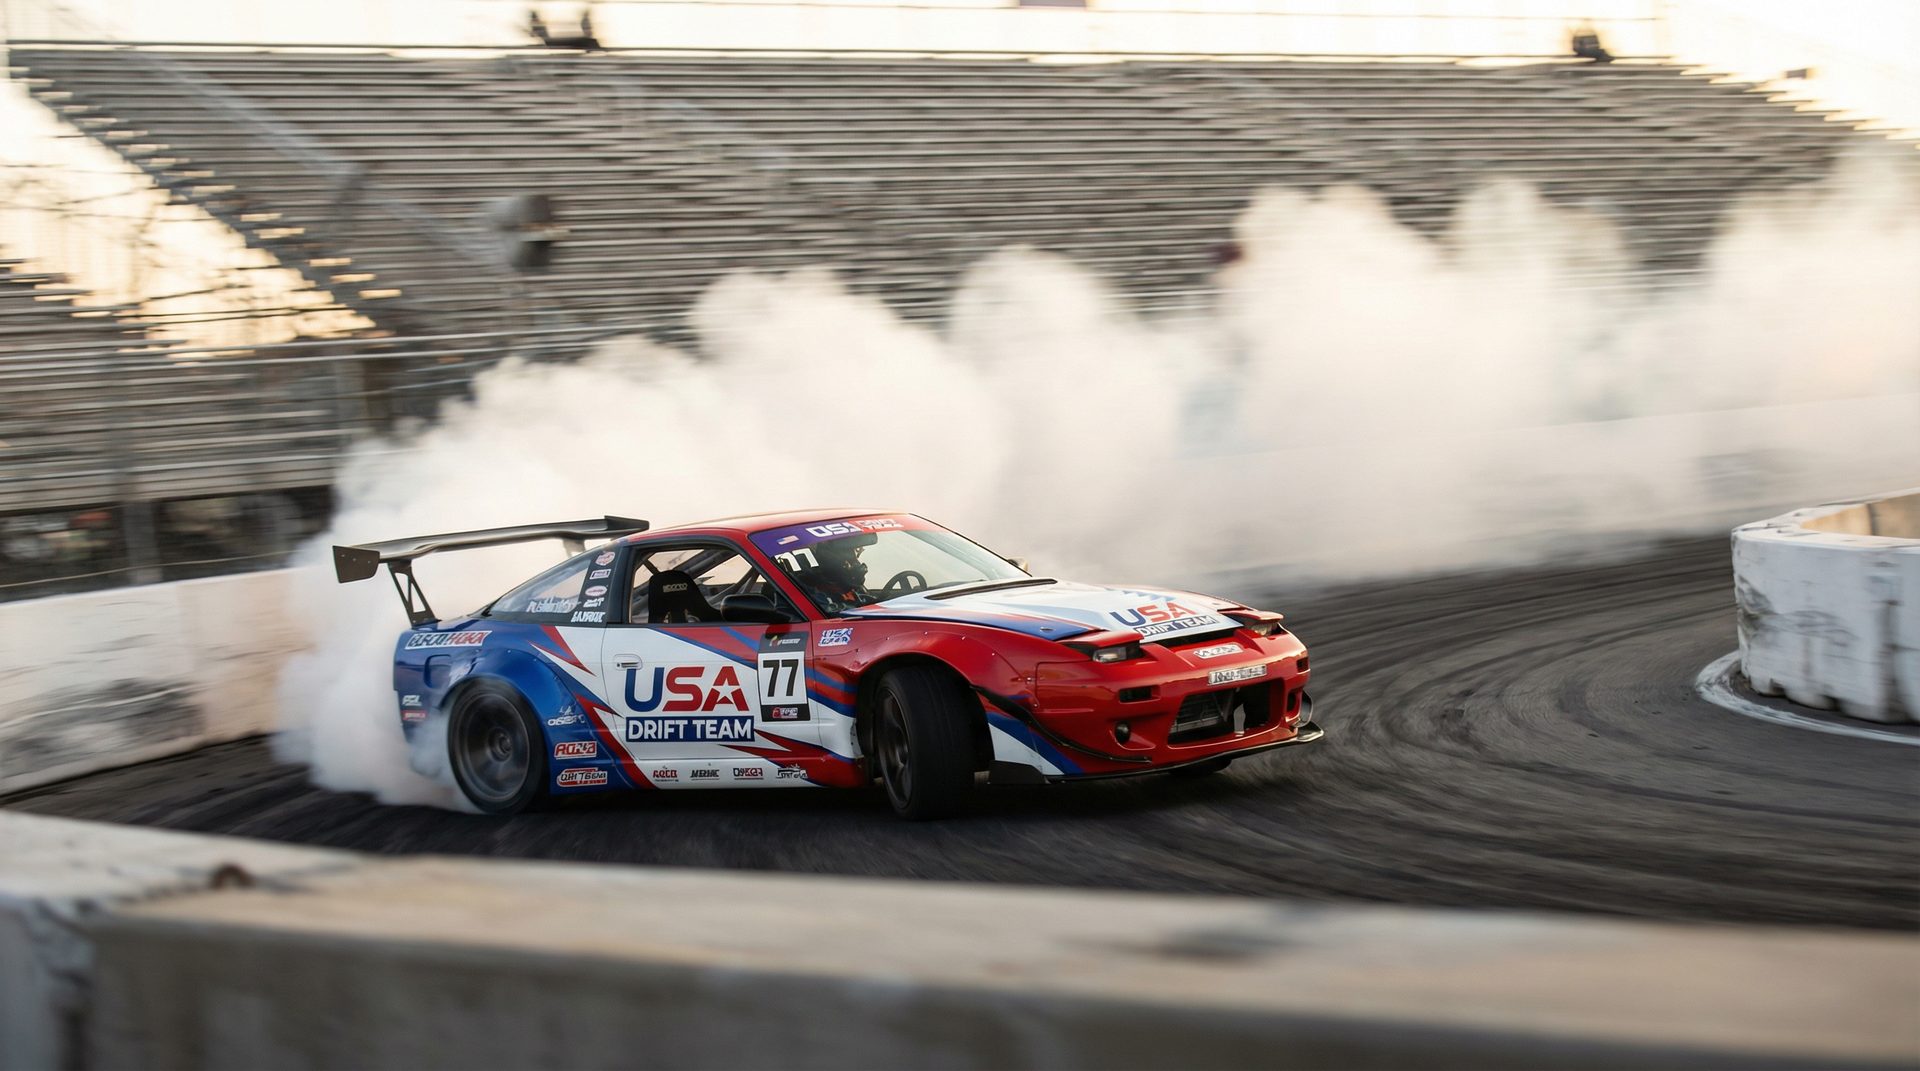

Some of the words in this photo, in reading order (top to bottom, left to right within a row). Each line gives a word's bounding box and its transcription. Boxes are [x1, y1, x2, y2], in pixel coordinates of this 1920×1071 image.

[1109, 602, 1197, 627] USA
[1137, 620, 1178, 637] DRIFT
[1178, 614, 1218, 630] TEAM
[625, 666, 750, 712] USA
[762, 659, 799, 697] 77
[628, 720, 688, 740] DRIFT
[692, 719, 752, 740] TEAM
